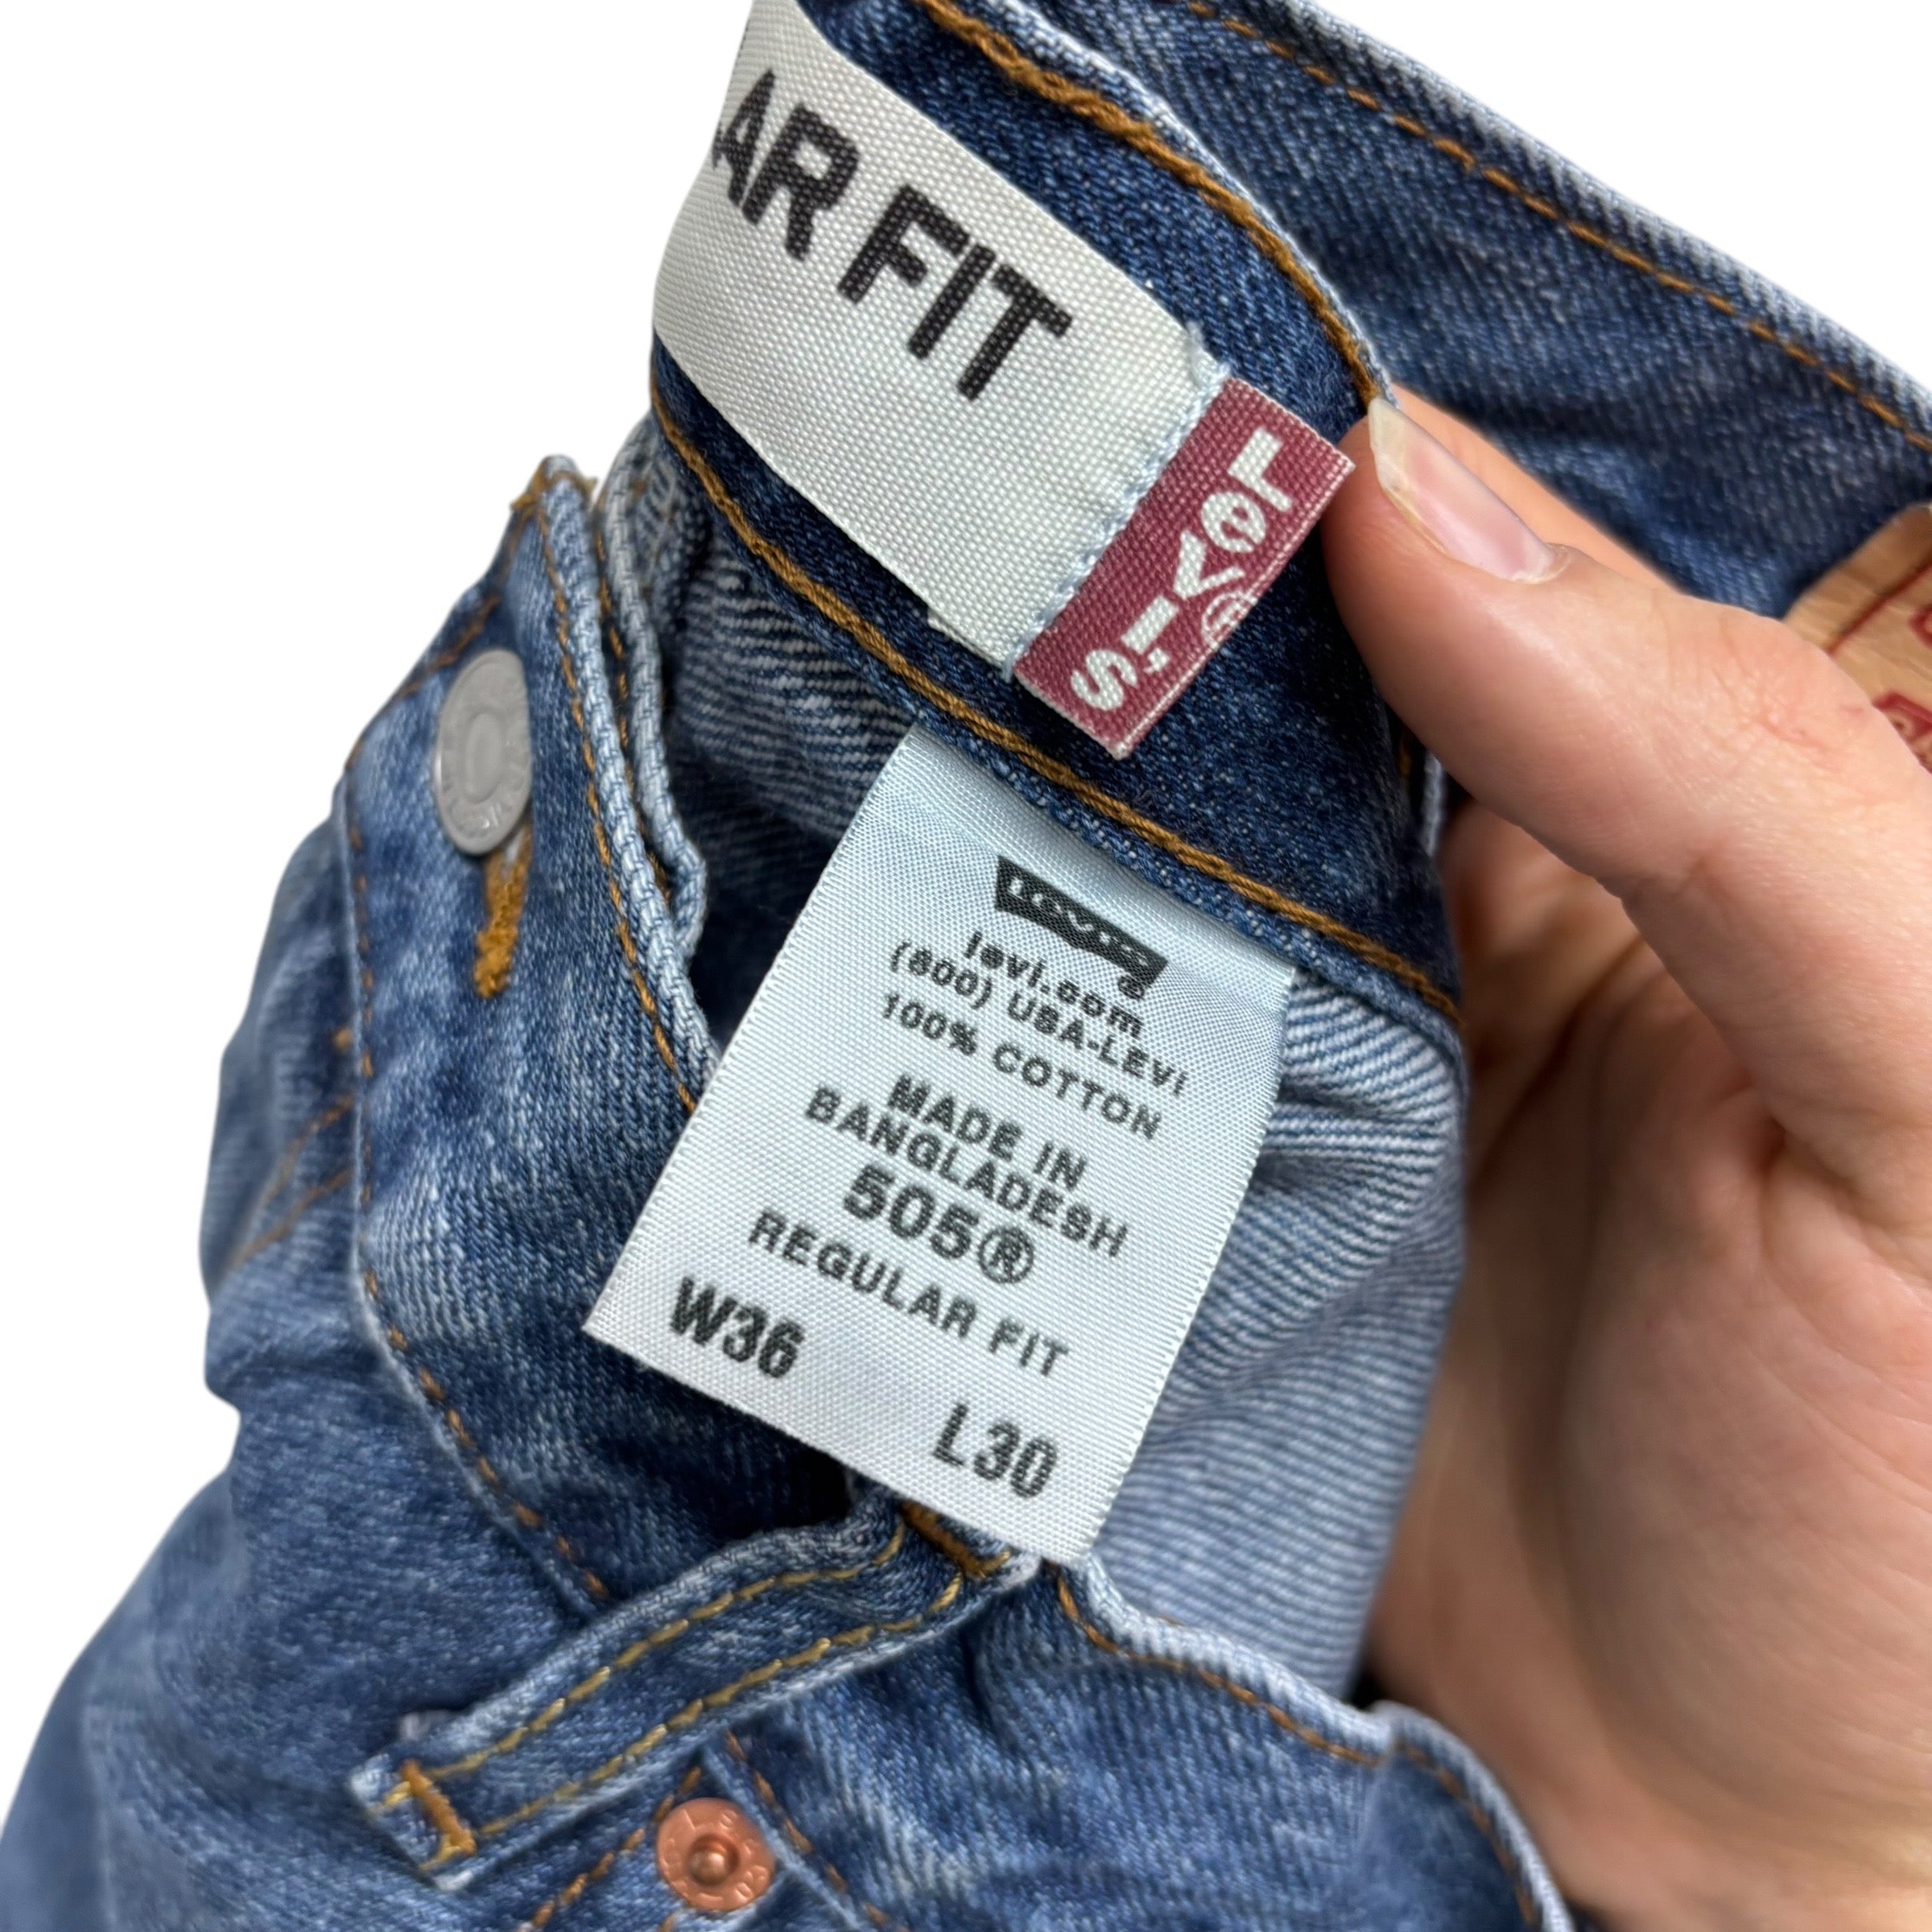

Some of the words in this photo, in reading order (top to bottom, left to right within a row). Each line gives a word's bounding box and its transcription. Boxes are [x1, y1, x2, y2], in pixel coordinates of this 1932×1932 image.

[712, 69, 860, 261] AR
[837, 186, 1072, 401] FIT
[891, 939, 993, 1010] (800)
[1008, 989, 1189, 1098] USA-LEVI
[966, 931, 1144, 1039] levi.com
[884, 992, 977, 1056] 100%
[993, 1043, 1162, 1139] COTTON
[886, 1074, 1022, 1161] MADE
[1033, 1141, 1088, 1191] IN
[805, 1086, 1129, 1257] BANGLADESH
[670, 1276, 805, 1379] W36
[748, 1209, 978, 1340] REGULAR
[988, 1317, 1069, 1377] FIT
[933, 1404, 1057, 1499] L30
